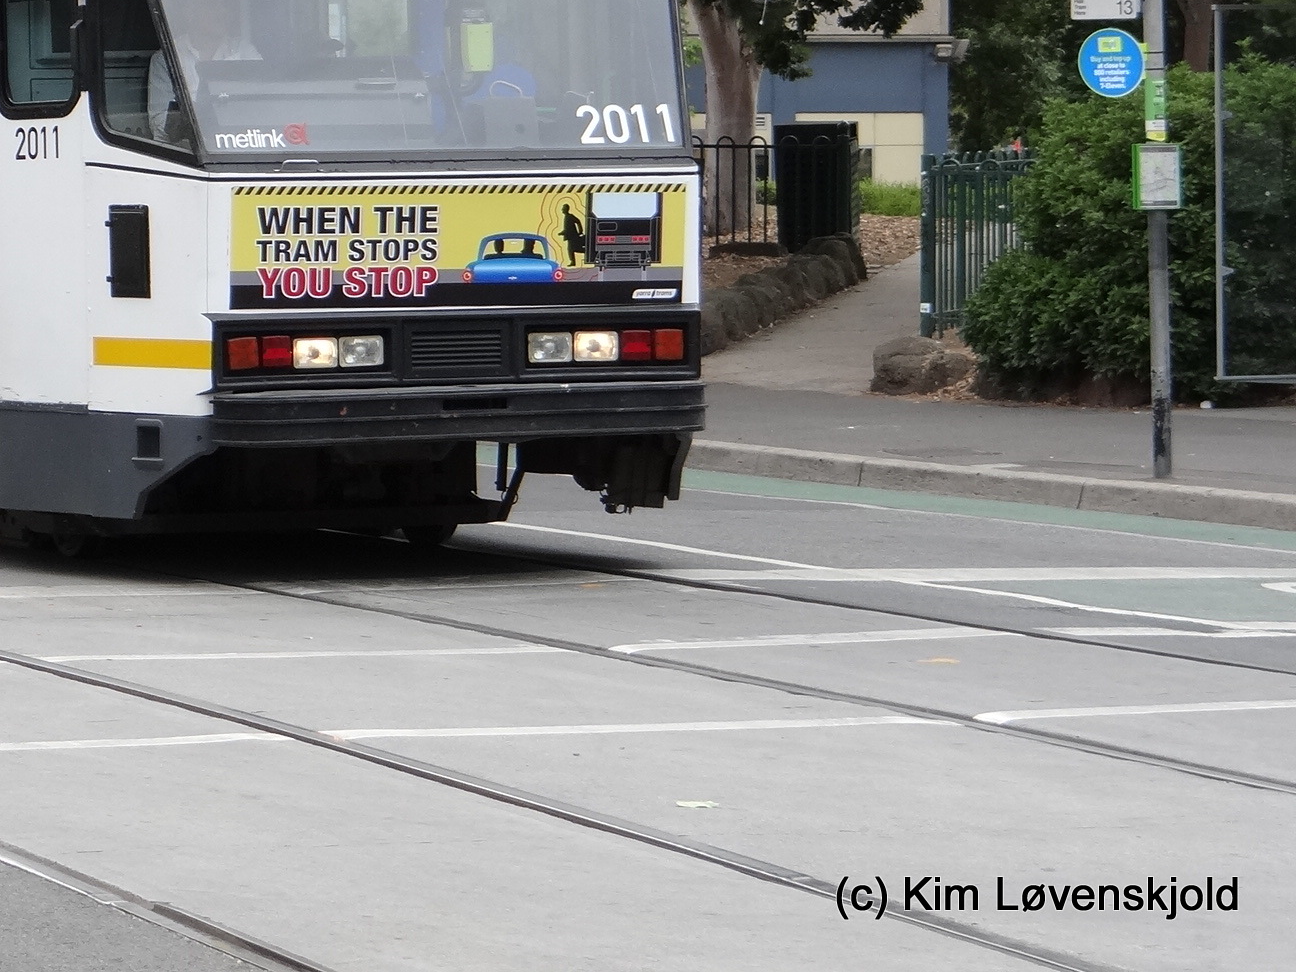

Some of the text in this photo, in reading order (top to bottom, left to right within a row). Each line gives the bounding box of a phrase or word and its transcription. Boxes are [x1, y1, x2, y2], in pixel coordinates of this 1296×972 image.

[1116, 0, 1134, 15] 13
[215, 129, 286, 148] metlink
[576, 103, 675, 144] 2011
[15, 125, 59, 160] 2011
[257, 205, 440, 236] WHEN THE
[256, 237, 439, 263] TRAM STOPS
[256, 266, 438, 298] YOU STOP
